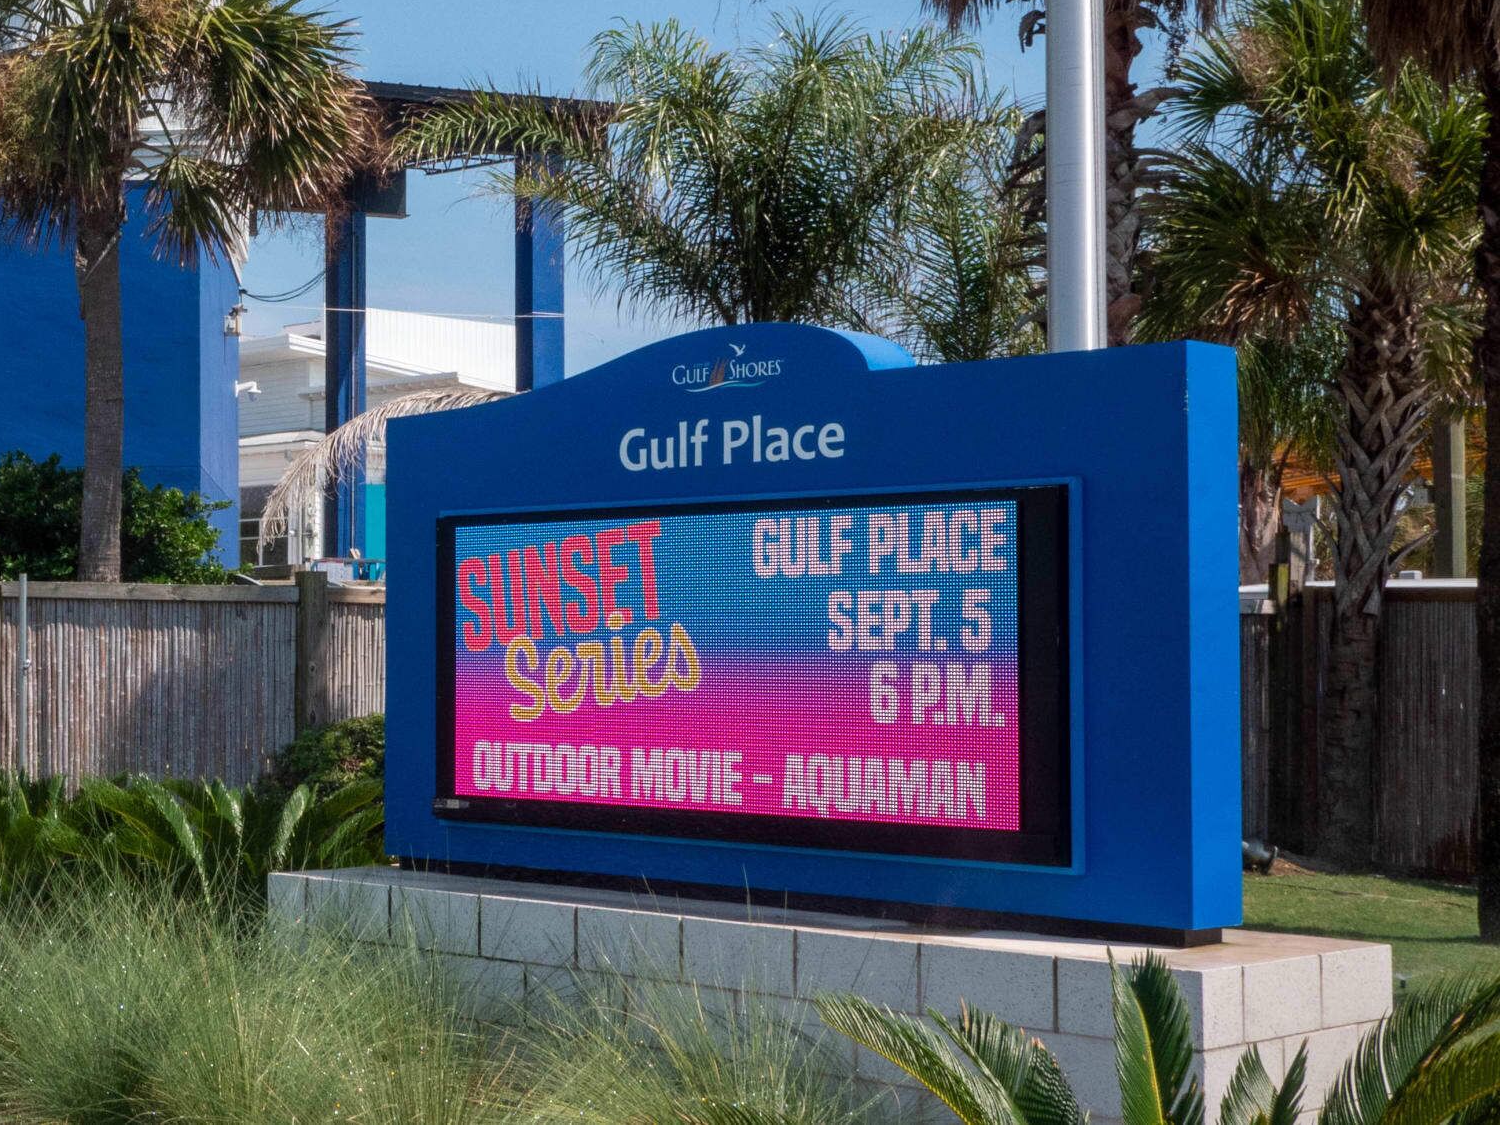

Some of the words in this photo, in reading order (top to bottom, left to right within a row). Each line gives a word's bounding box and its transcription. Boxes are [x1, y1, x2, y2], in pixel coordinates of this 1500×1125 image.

[672, 365, 709, 385] GULF
[729, 359, 781, 380] SHORES
[619, 419, 709, 472] Gulf
[723, 414, 845, 465] Place
[752, 515, 852, 579] GULF
[868, 508, 1007, 575] PLACE
[456, 519, 662, 652] SUNSET
[827, 589, 949, 651] SEPT.
[961, 589, 991, 652] 5
[505, 611, 702, 722] Series
[870, 660, 898, 724] 6
[911, 660, 1006, 727] P.M.
[472, 739, 621, 798] OUTDOOR
[631, 746, 742, 807] MOVIE
[782, 753, 986, 820] AQUAMAN
